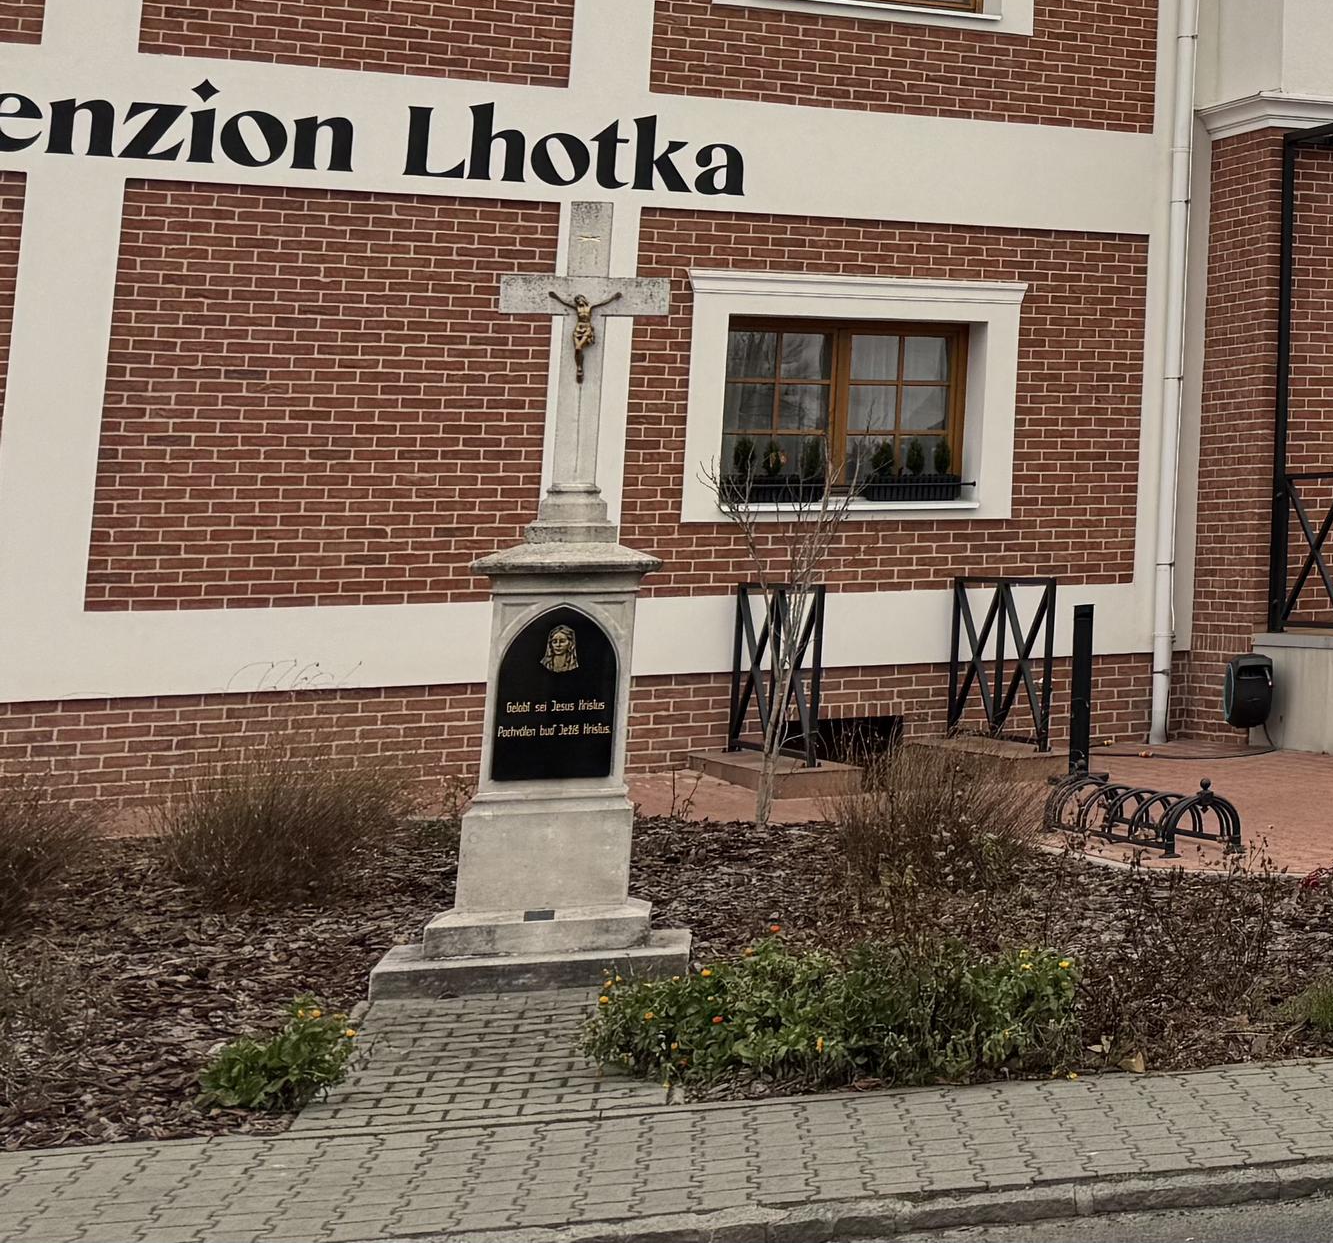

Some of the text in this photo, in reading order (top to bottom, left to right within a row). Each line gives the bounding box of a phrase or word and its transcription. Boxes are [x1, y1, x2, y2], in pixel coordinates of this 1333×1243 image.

[402, 101, 746, 196] Lhotka
[535, 701, 547, 712] sei
[551, 700, 575, 712] Jesus
